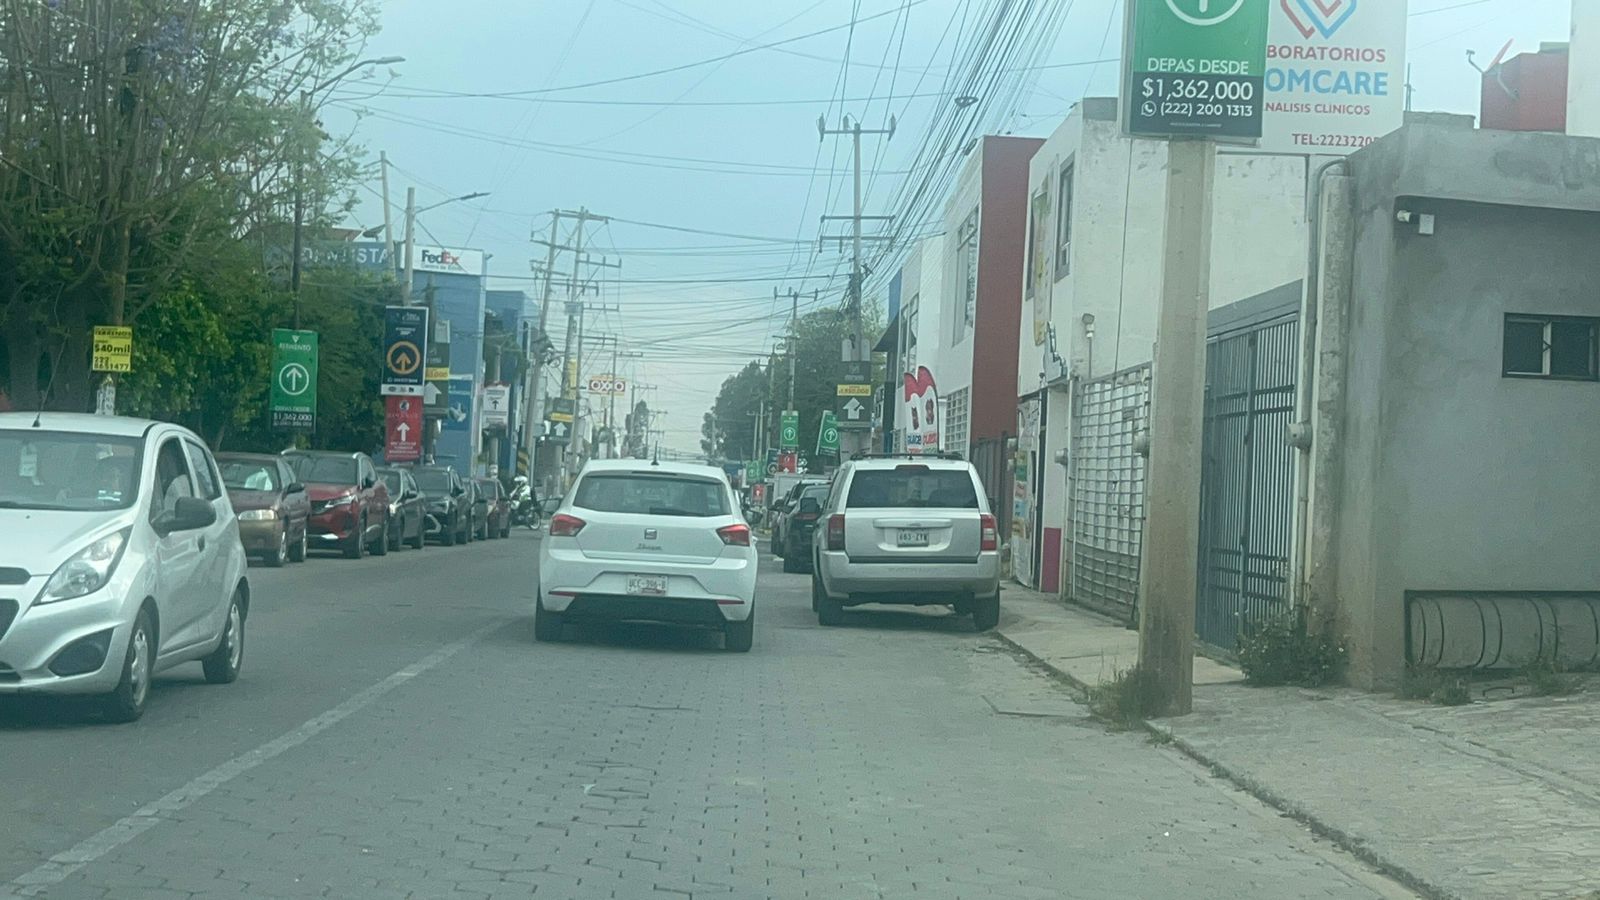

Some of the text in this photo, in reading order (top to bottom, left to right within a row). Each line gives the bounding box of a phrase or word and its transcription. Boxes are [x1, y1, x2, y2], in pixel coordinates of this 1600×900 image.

[1147, 57, 1249, 75] DEPAS DESDE
[1142, 78, 1254, 102] $1,362,000
[1160, 102, 1253, 117] (222) 200 1313
[1292, 133, 1380, 148] TEL:2223220
[421, 249, 460, 265] FedEx
